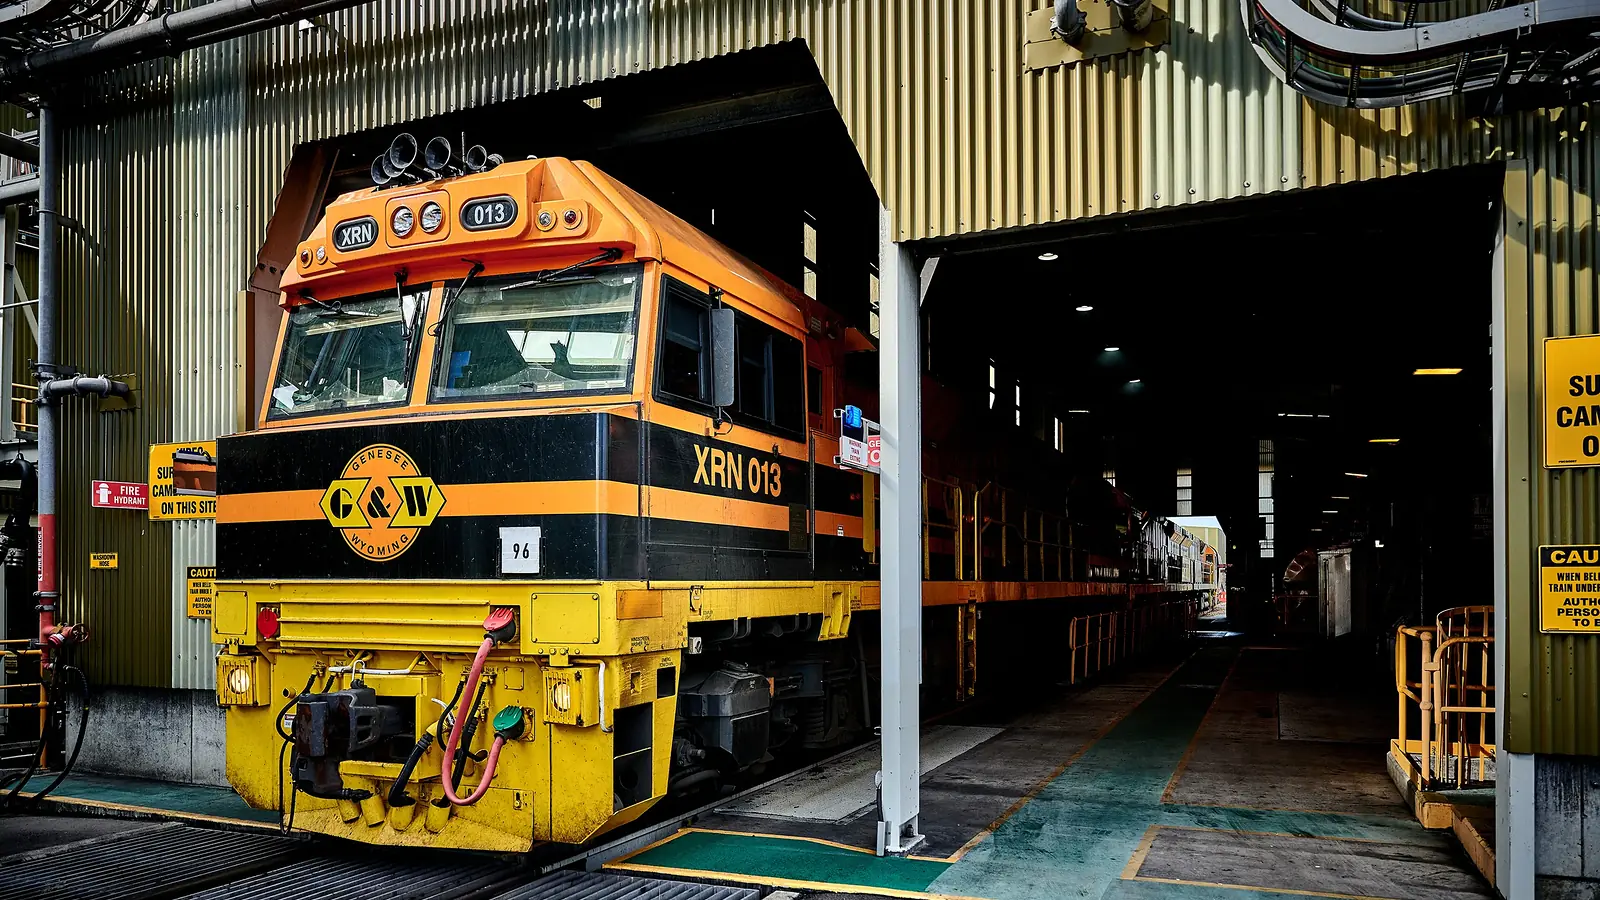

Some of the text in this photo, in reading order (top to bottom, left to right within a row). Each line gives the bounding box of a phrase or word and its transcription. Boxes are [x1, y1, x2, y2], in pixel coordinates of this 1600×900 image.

[341, 203, 505, 247] XRN 013
[1569, 375, 1600, 397] SU
[351, 449, 409, 472] GENESEE
[868, 449, 880, 463] O
[693, 443, 782, 497] XRN 013
[120, 485, 140, 496] FIRE
[113, 496, 146, 505] HYDRANT
[161, 501, 174, 515] ON
[176, 501, 197, 514] THIS
[351, 532, 409, 556] WYOMING
[512, 542, 530, 560] 96
[1550, 550, 1599, 564] CAU
[1557, 572, 1580, 581] WHEN
[1548, 583, 1573, 593] TRAIN
[1572, 618, 1591, 627] TO
